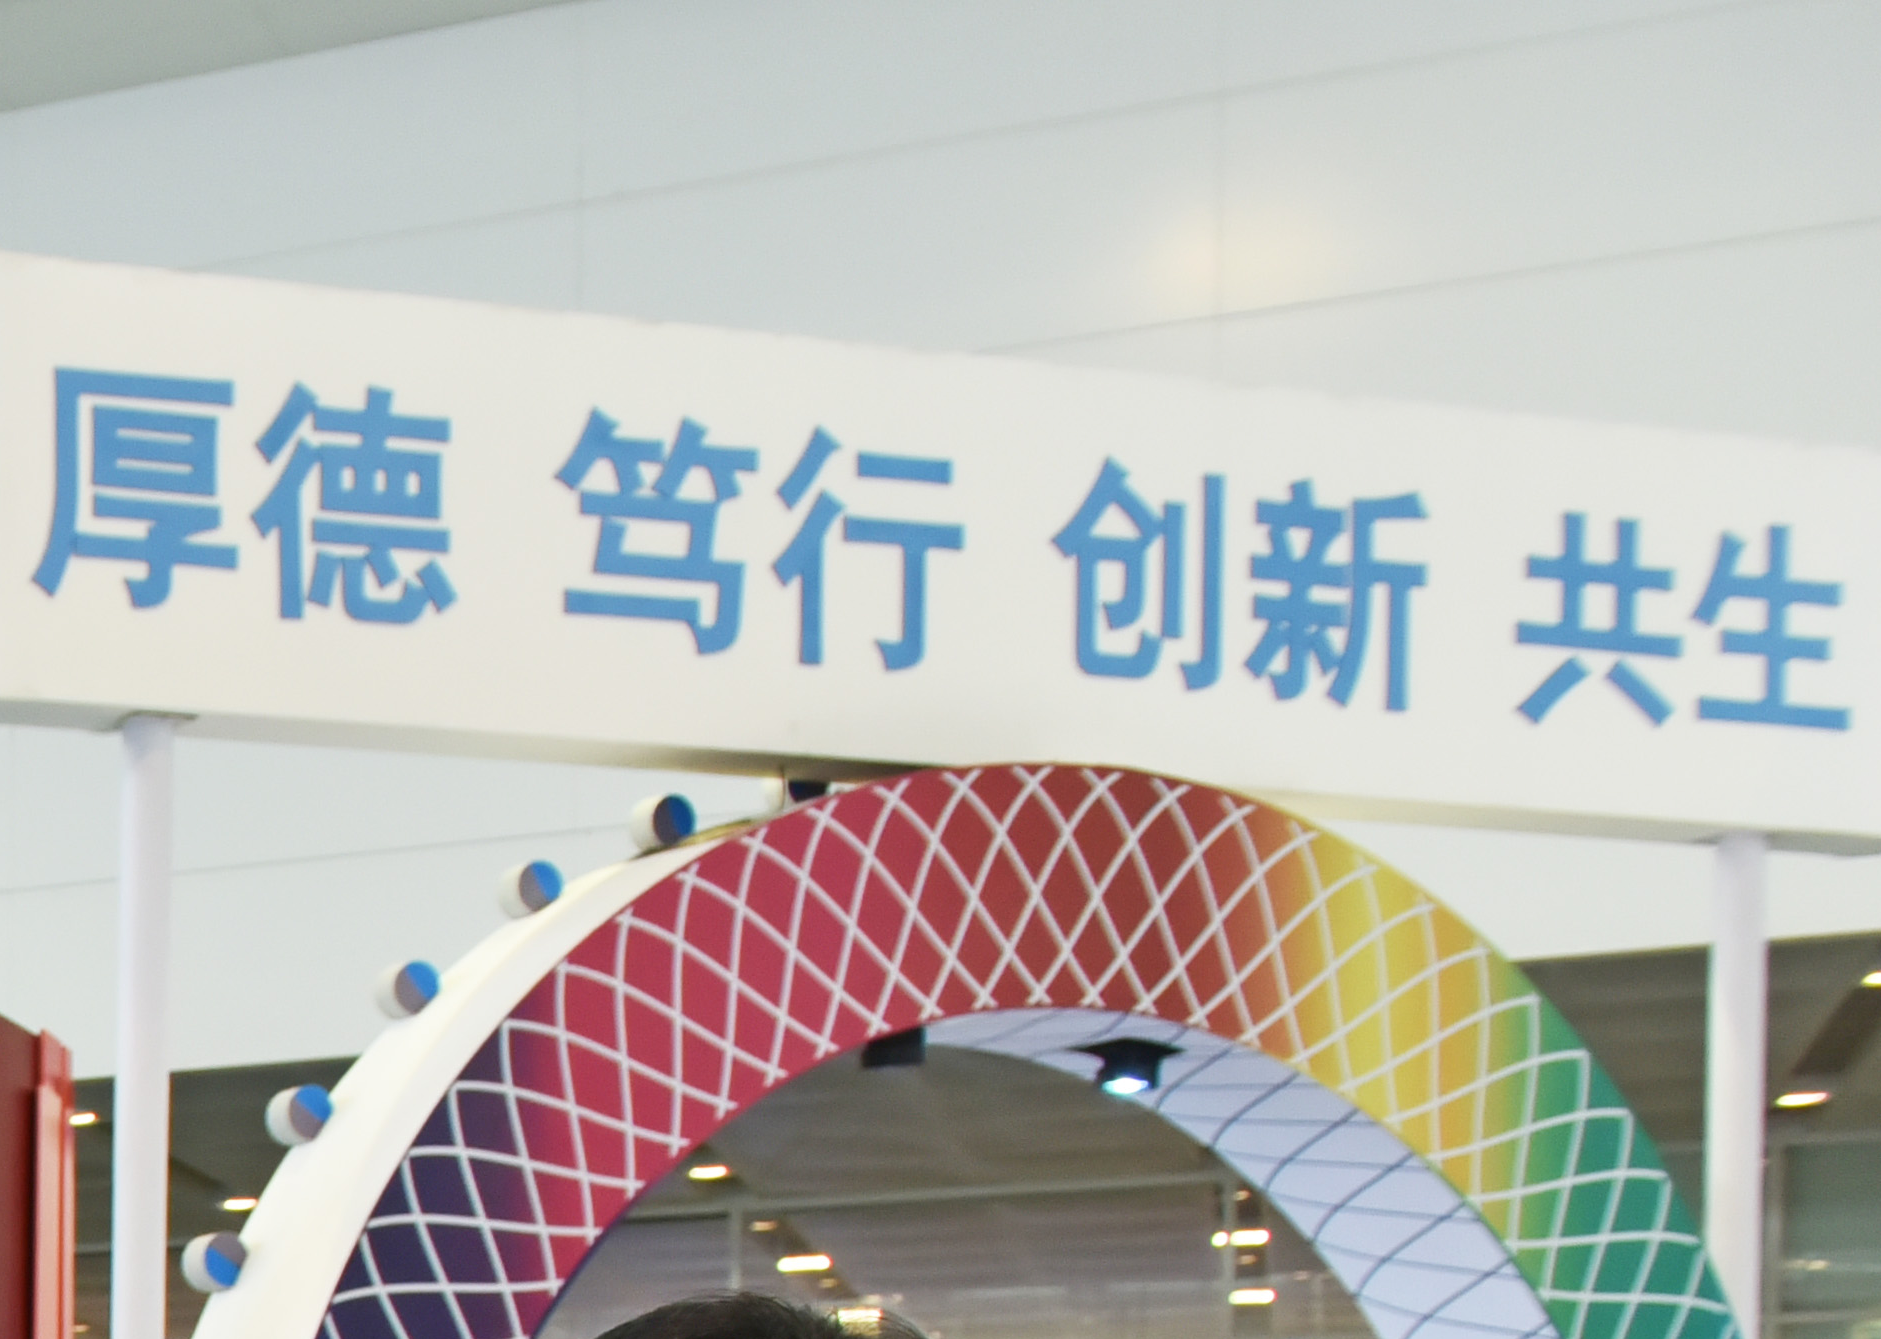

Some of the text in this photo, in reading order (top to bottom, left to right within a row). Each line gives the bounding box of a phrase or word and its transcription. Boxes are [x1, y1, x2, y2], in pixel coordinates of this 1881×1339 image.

[33, 367, 1852, 732] 厚德 笃行 创新 共生
